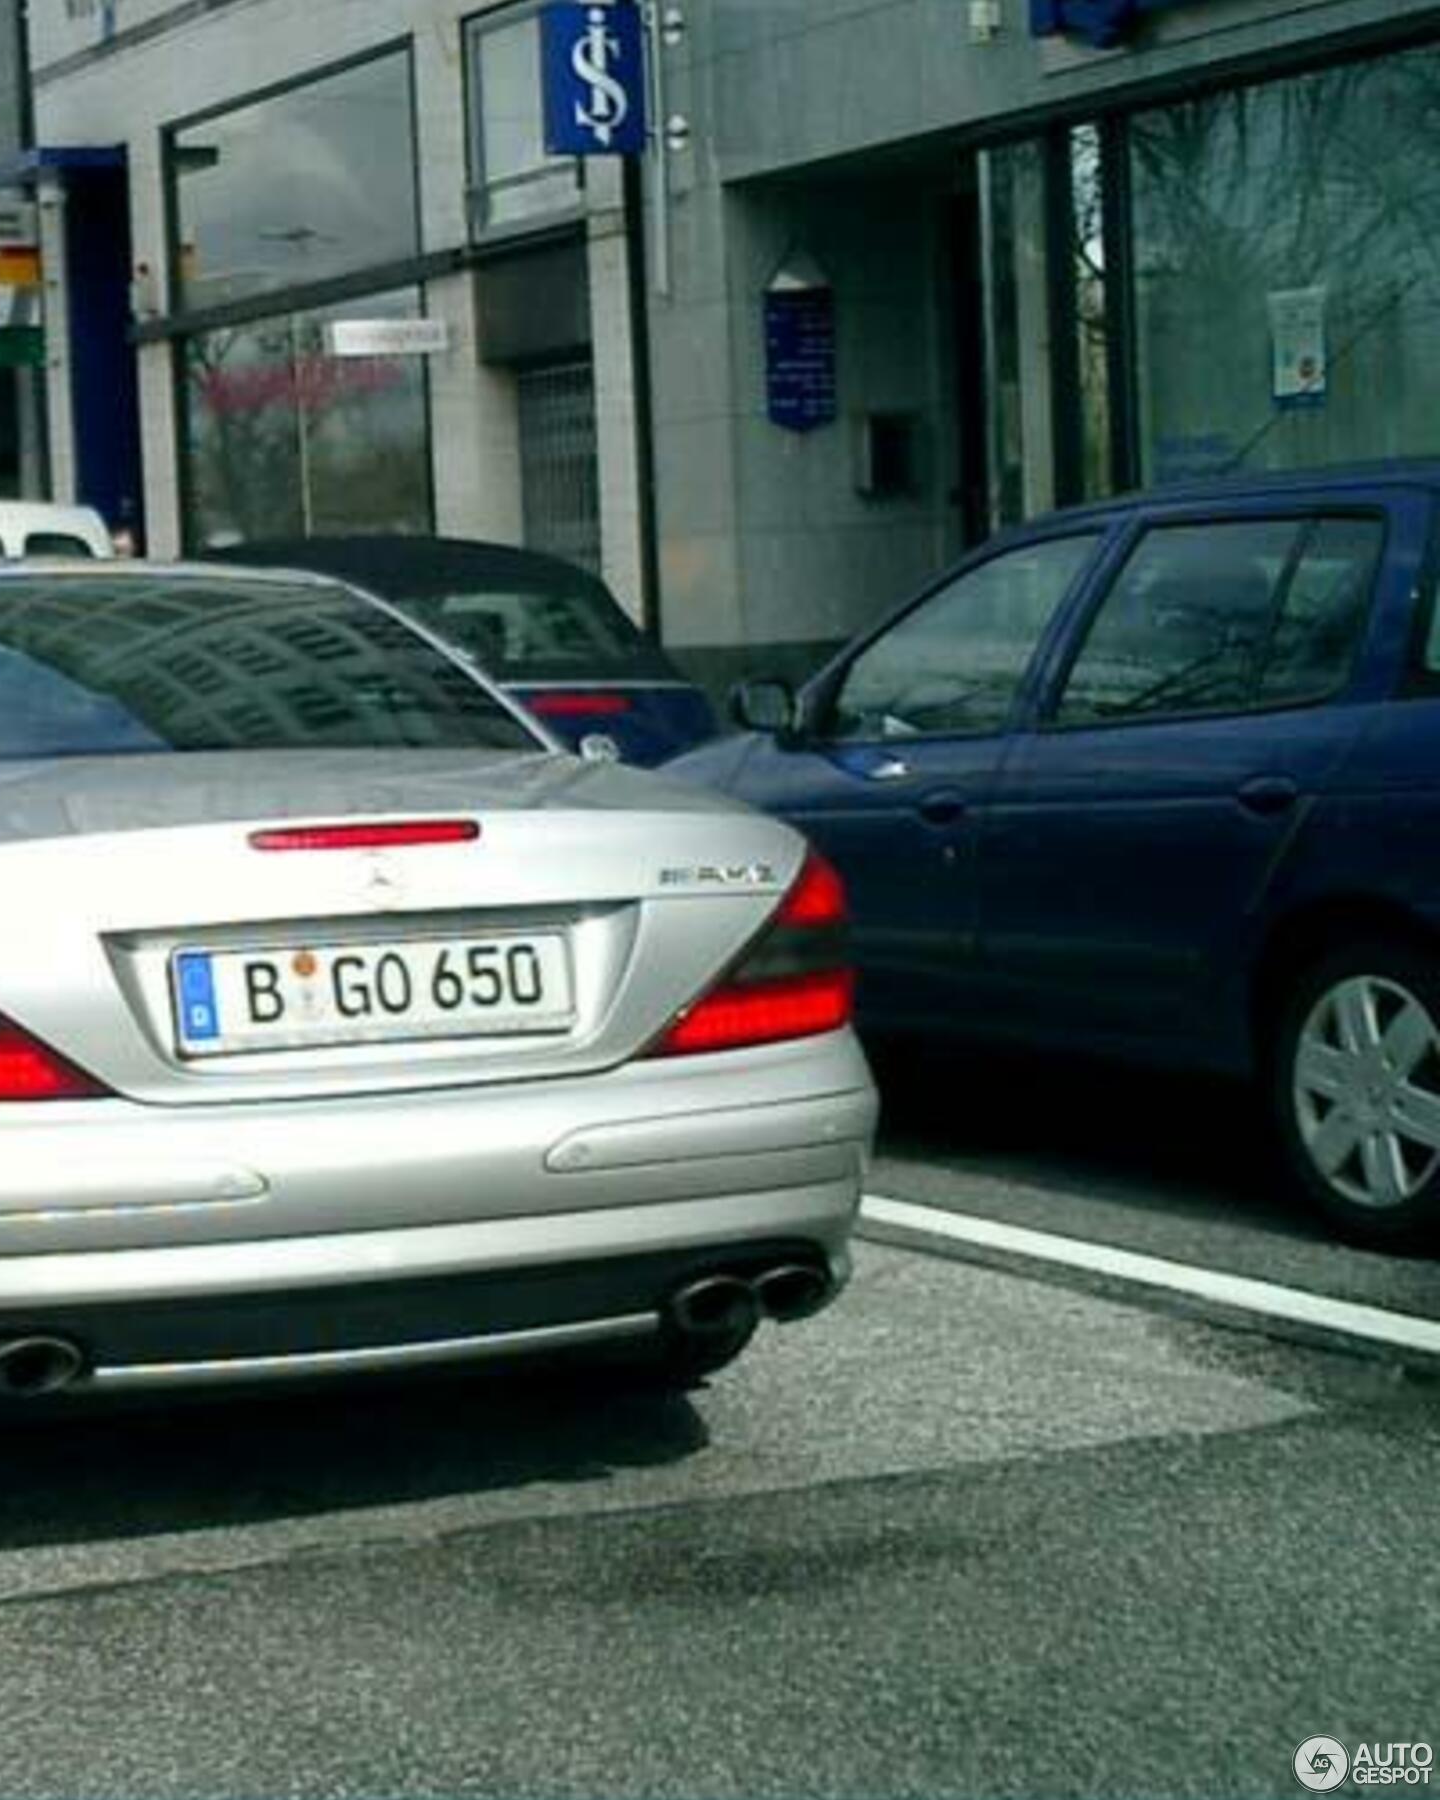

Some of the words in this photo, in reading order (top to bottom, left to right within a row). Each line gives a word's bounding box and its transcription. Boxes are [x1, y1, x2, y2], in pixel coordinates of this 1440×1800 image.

[243, 961, 285, 1023] B
[331, 953, 412, 1017] GO
[432, 944, 543, 1010] 650
